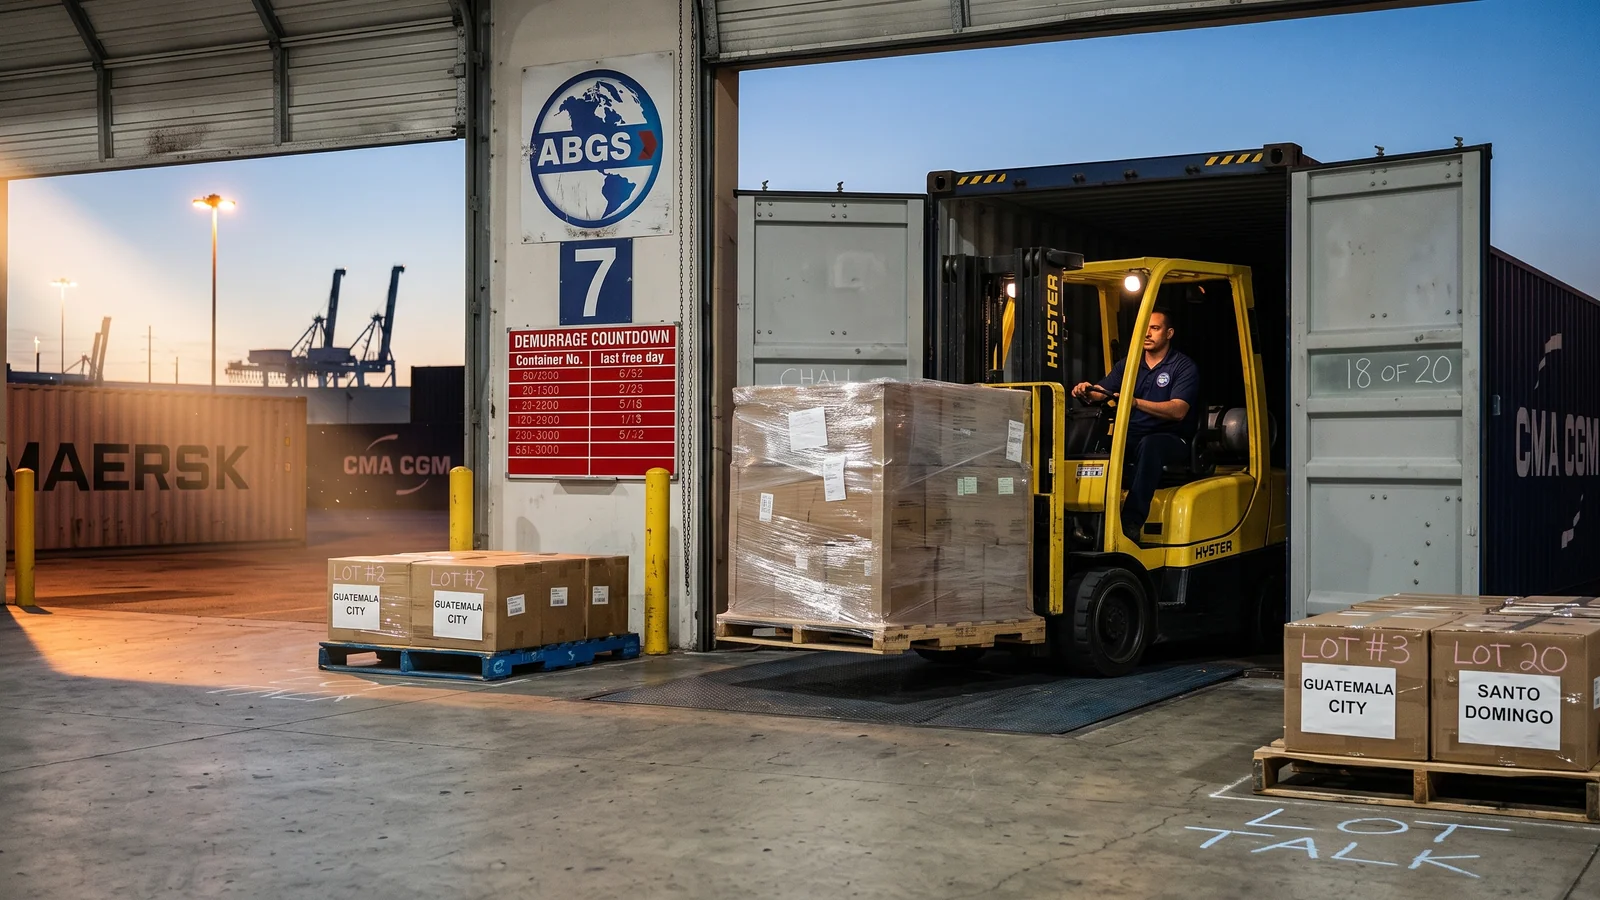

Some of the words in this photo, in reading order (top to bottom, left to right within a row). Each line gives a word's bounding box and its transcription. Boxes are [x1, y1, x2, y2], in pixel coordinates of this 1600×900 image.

[537, 131, 632, 167] ABGS
[575, 247, 617, 317] 7
[1047, 274, 1058, 368] HYSTER
[514, 332, 588, 349] DEMURRAGE
[591, 329, 670, 346] COUNTDOWN
[516, 354, 563, 366] Container
[566, 353, 583, 365] No.
[600, 352, 619, 364] last
[622, 352, 642, 363] free
[646, 351, 664, 364] day
[1347, 357, 1372, 390] 18
[1381, 363, 1410, 383] OF
[1415, 355, 1453, 384] 20
[522, 385, 560, 395] 20-1500
[515, 430, 560, 440] 230-3000
[1515, 406, 1560, 478] CMA
[1564, 413, 1600, 477] CGM
[343, 455, 394, 475] CMA
[400, 455, 451, 475] CGM
[1195, 540, 1233, 560] HYSTER
[333, 563, 362, 581] LOT
[430, 569, 461, 588] LOT
[463, 569, 488, 591] #2
[333, 592, 379, 603] GUATEMALA
[434, 600, 483, 612] GUATEMALA
[346, 606, 366, 616] CITY
[447, 614, 468, 625] CITY
[1301, 632, 1360, 662] LOT
[1366, 633, 1411, 664] #3
[1453, 640, 1511, 668] LOT
[1519, 642, 1568, 673] 20
[1303, 678, 1394, 696] GUATEMALA
[1477, 683, 1540, 702] SANTO
[1328, 699, 1367, 715] CITY
[1465, 704, 1554, 725] DOMINGO
[1245, 808, 1514, 843] LOT
[1184, 826, 1481, 878] TALK
